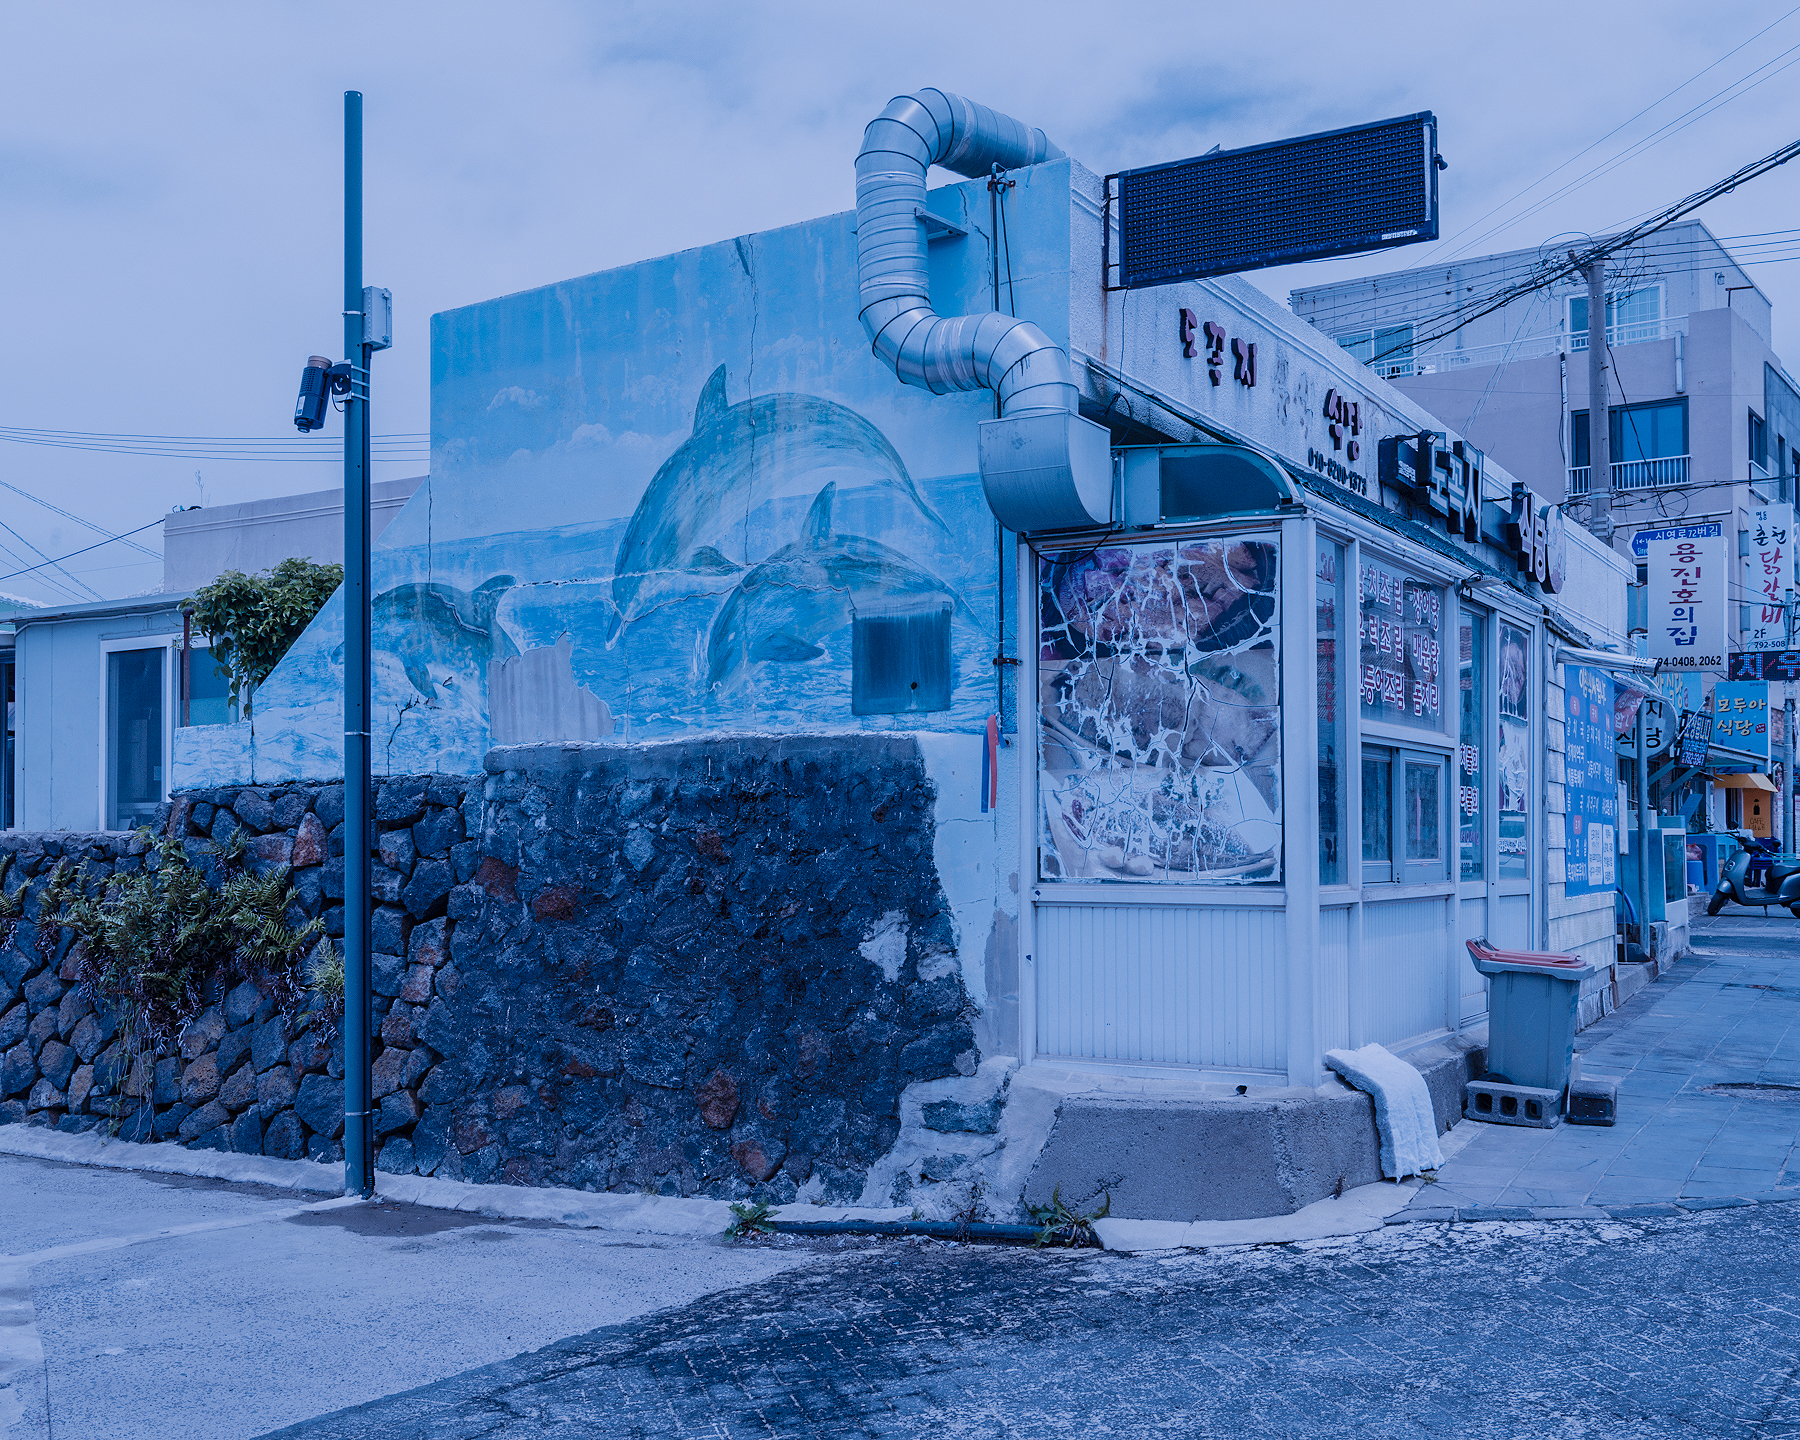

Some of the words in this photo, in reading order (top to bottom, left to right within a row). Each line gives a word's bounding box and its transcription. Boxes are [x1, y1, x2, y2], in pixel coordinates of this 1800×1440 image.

[1323, 389, 1363, 461] 식당
[1307, 446, 1367, 497] 010-8200-1373
[1516, 486, 1546, 583] 식당
[1753, 524, 1787, 546] 춘천
[1666, 543, 1703, 646] 용진호의집
[1759, 547, 1783, 625] 닭갈비
[1413, 586, 1440, 632] 장어탕
[1754, 628, 1767, 639] 2F
[1754, 640, 1786, 649] 792-508
[1699, 655, 1722, 666] 2062
[1717, 697, 1767, 714] 모두아
[1615, 727, 1663, 749] 식당
[1717, 719, 1753, 736] 식당
[1459, 743, 1479, 776] 치물회
[1459, 785, 1479, 817] 리물회
[1460, 830, 1480, 846] 서오세요
